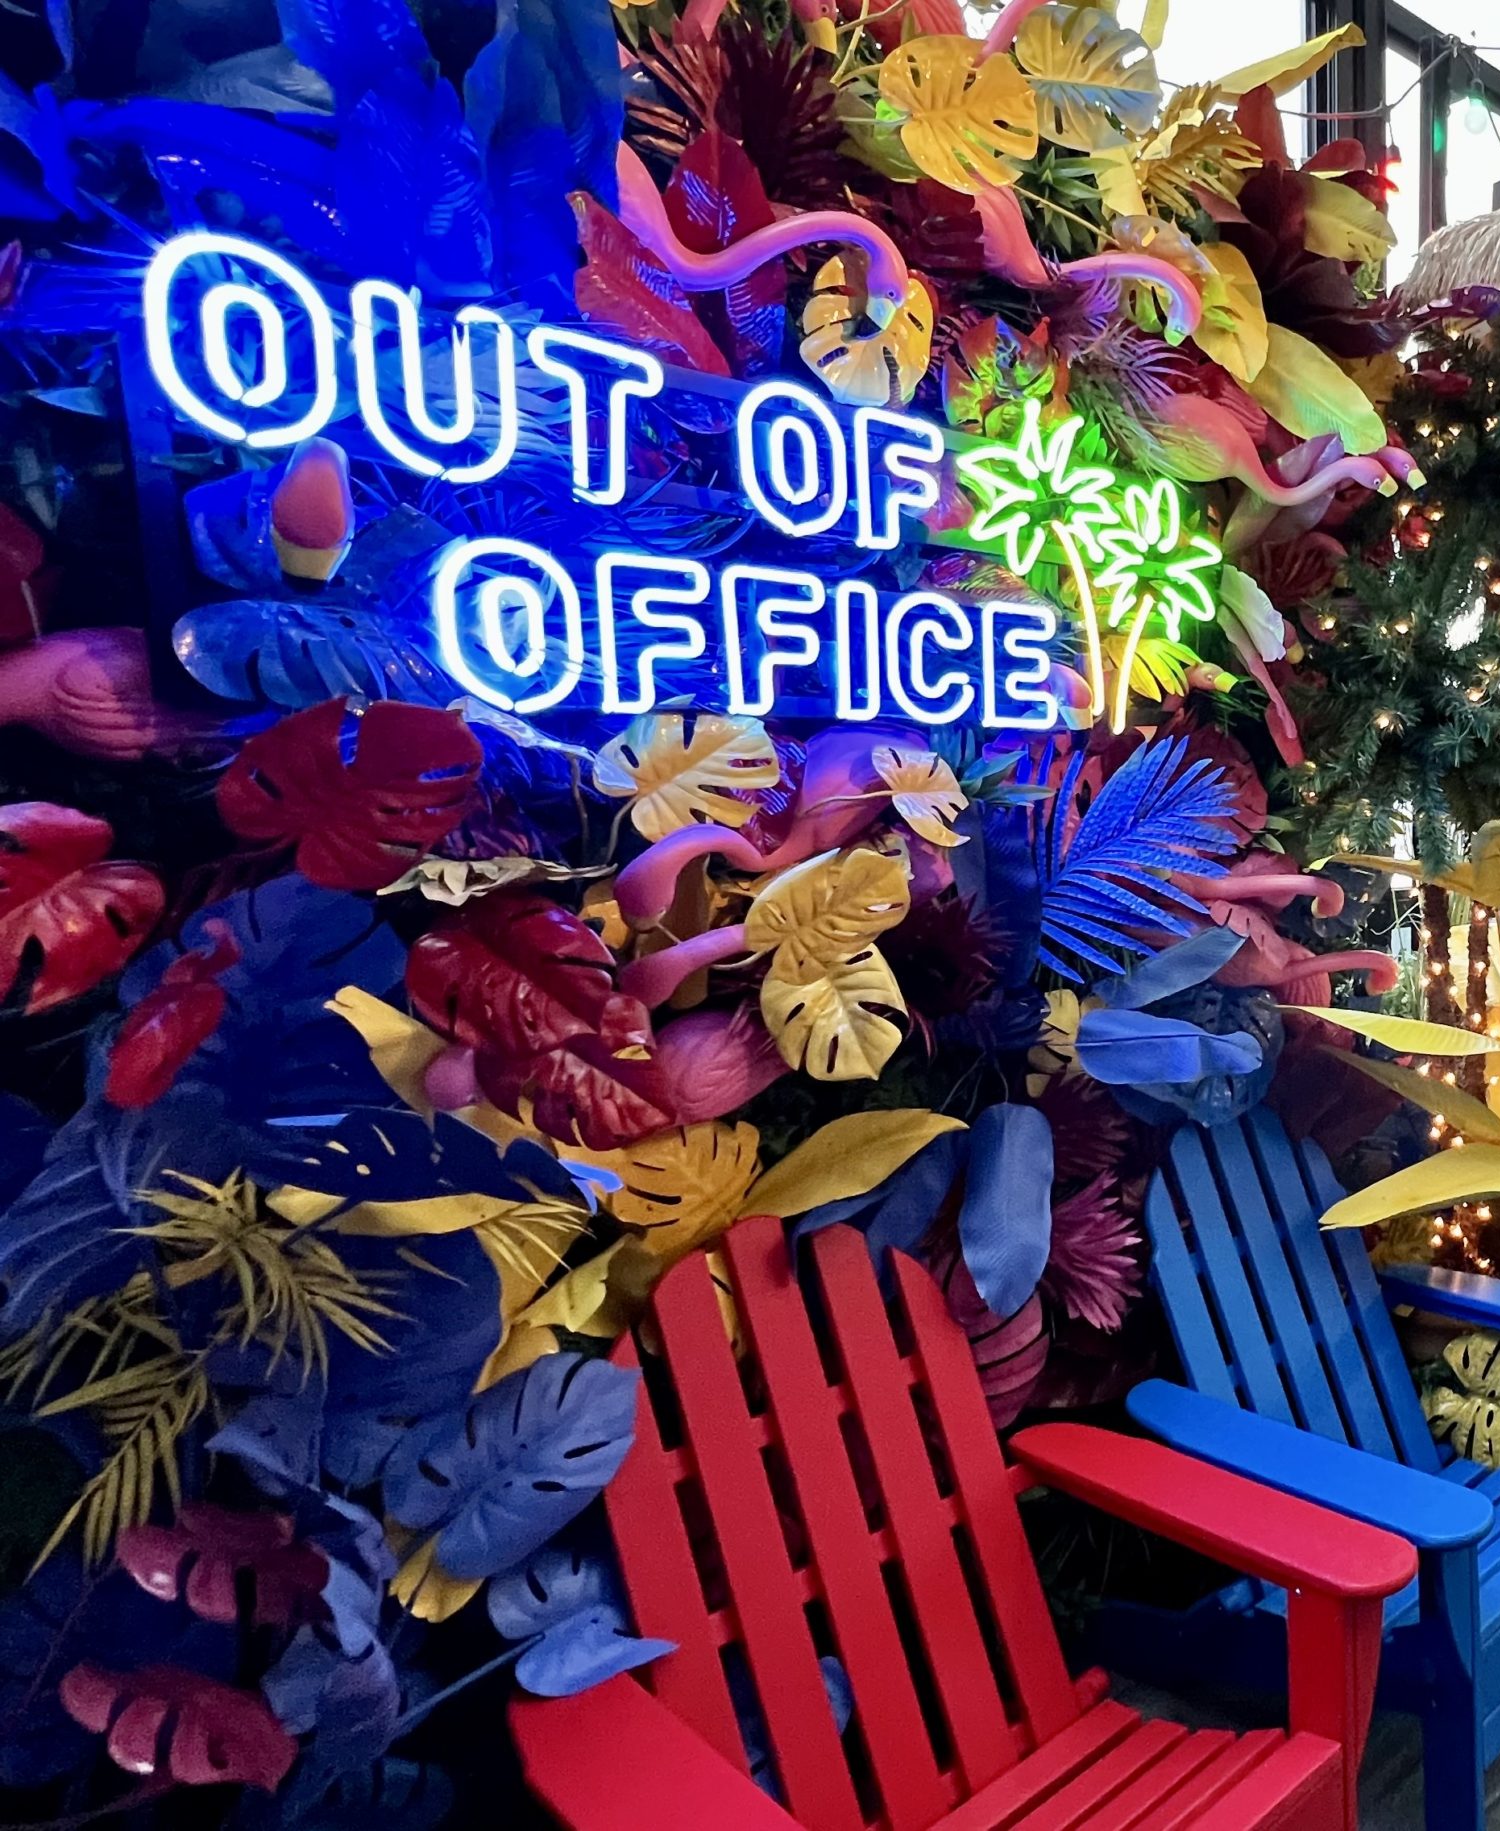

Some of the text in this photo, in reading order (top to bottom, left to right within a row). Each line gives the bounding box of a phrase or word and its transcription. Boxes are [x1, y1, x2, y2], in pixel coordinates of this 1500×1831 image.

[142, 230, 946, 551] OUT OF
[431, 536, 1060, 731] OFFICE
